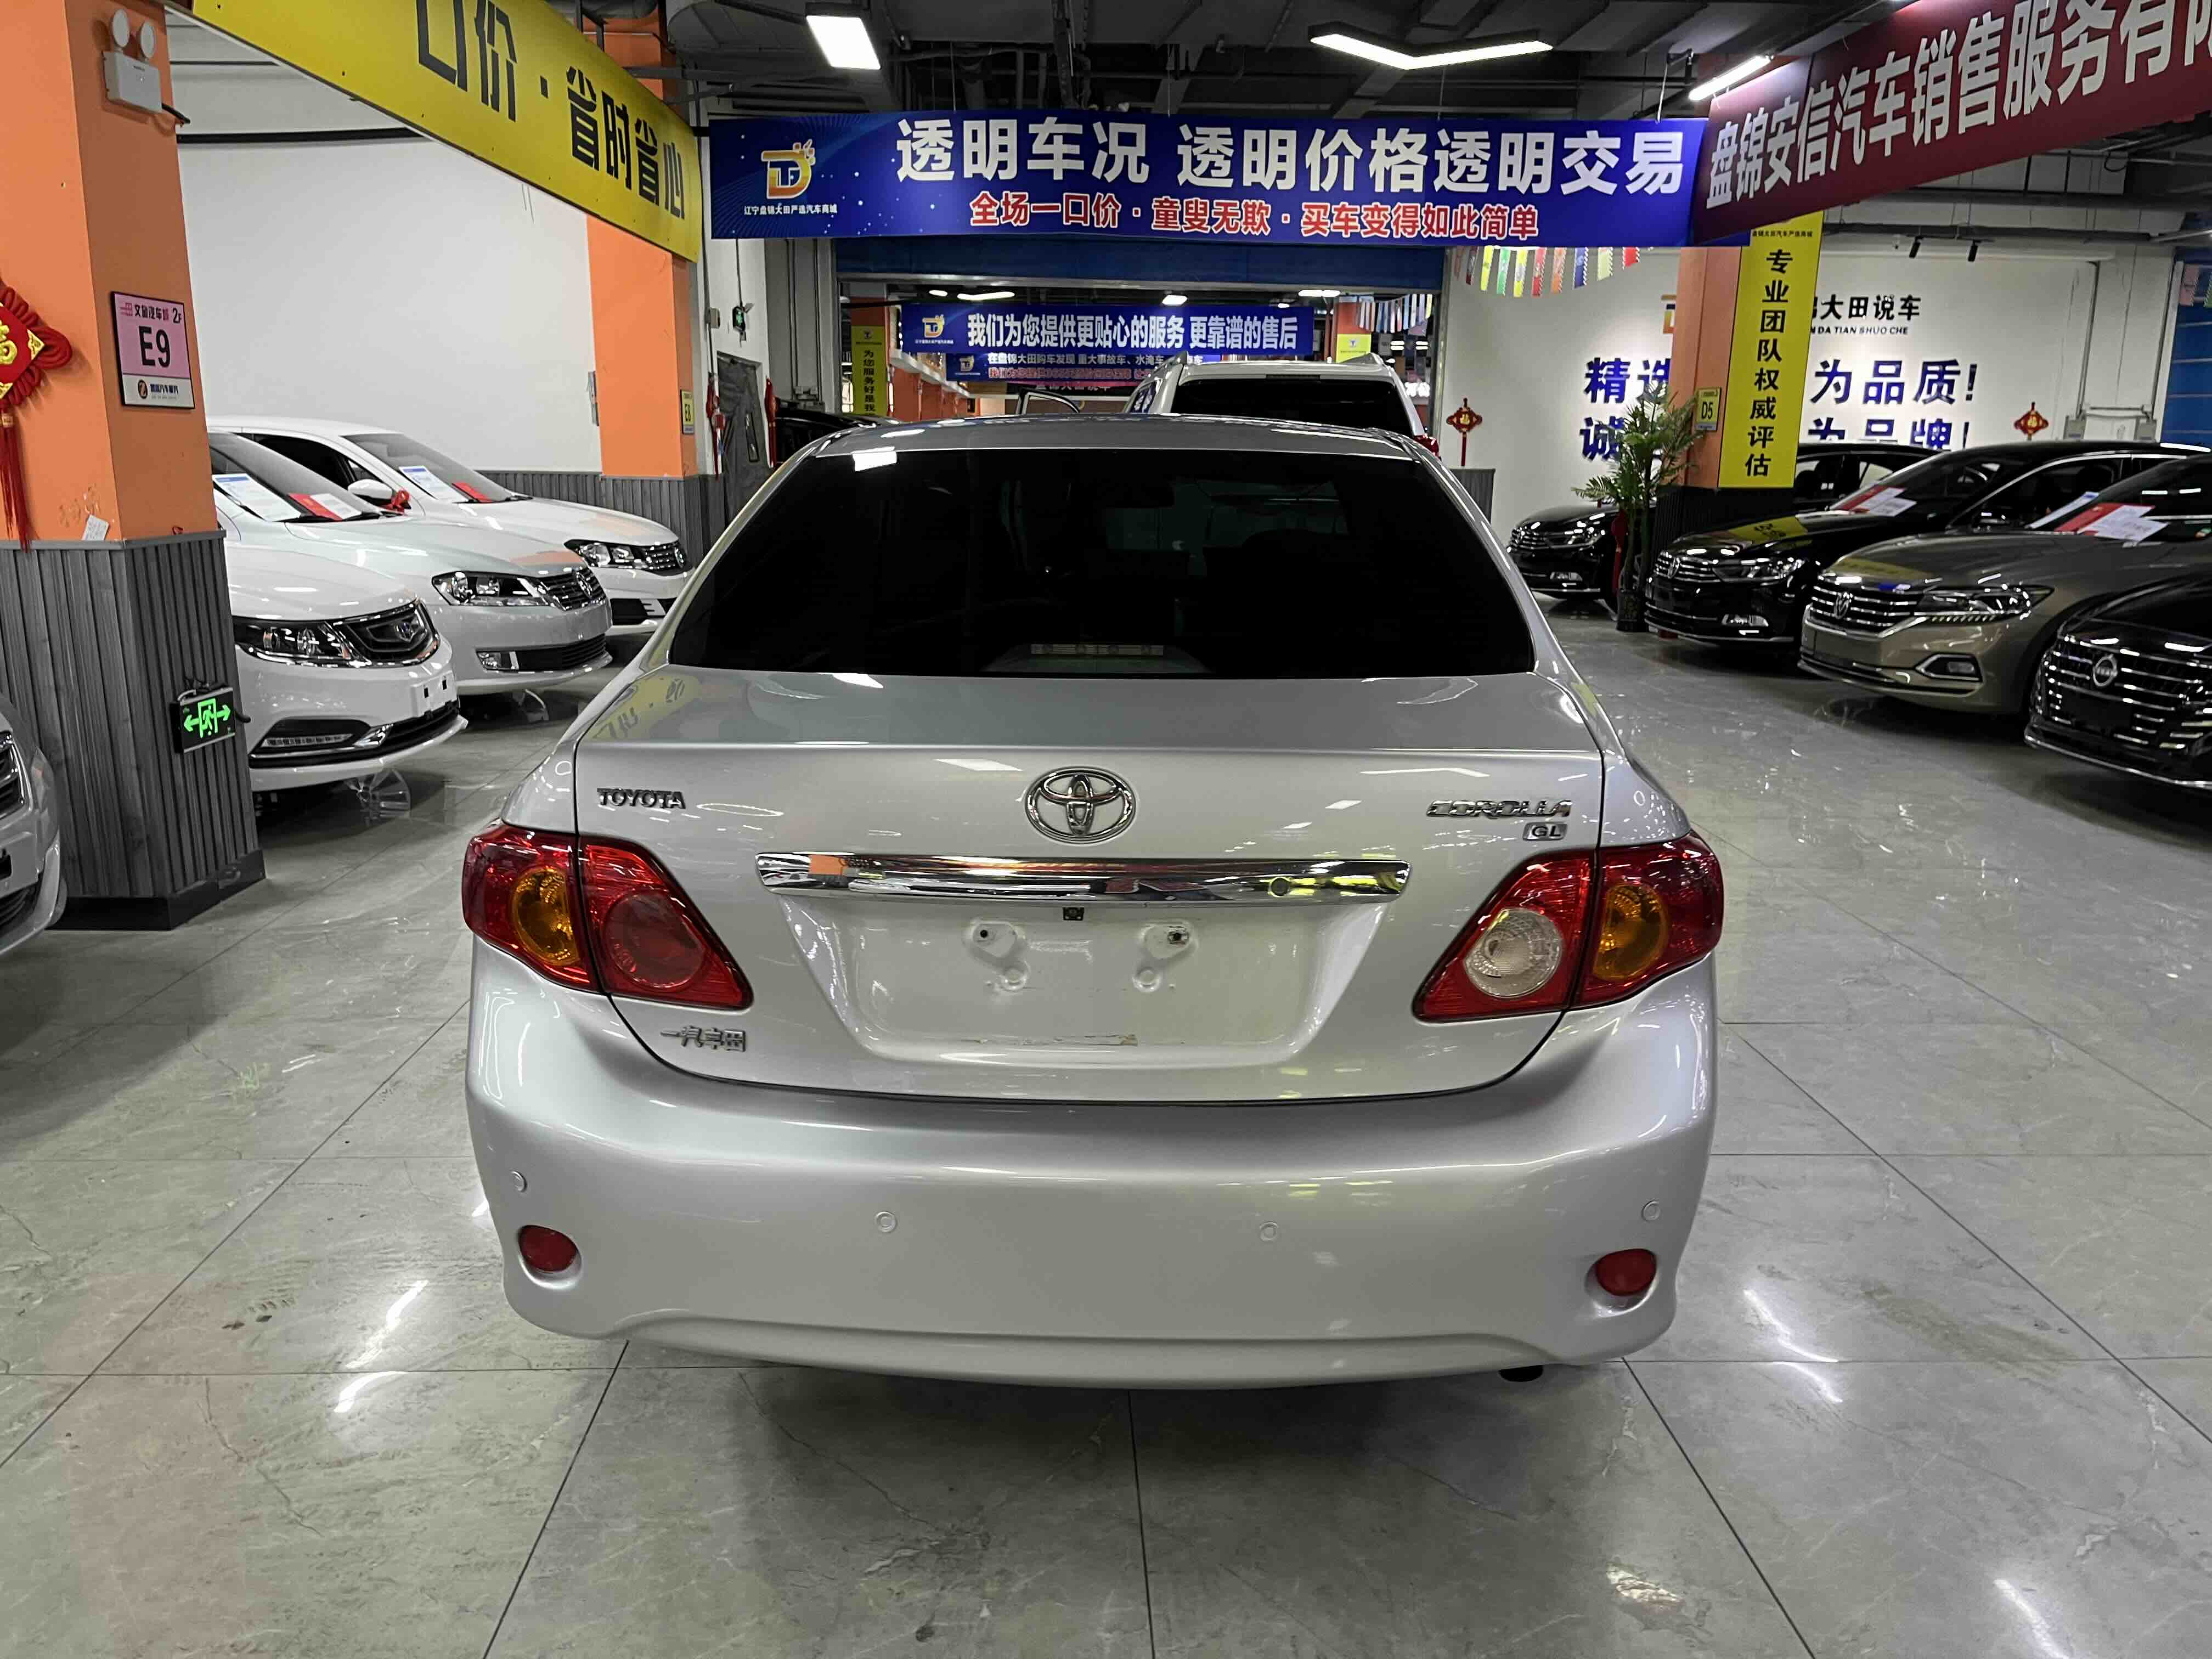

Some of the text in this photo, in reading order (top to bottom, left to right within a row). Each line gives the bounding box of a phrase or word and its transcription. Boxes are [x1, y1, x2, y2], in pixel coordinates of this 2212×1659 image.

[896, 116, 1683, 195] 透明车况 透明价格透明交易
[968, 313, 1298, 349] 我们为您提供更贴心的服务 更靠谱的售后
[1889, 326, 1908, 335] CHE
[139, 325, 171, 368] E9
[1745, 249, 1793, 477] 专业团队权威评估
[864, 350, 874, 415] 为您服务好是我
[1701, 401, 1713, 420] D5
[597, 788, 686, 809] TOYOTA
[1426, 800, 1572, 819] COROLLA
[1531, 826, 1561, 837] GL
[660, 1025, 746, 1052] 一汽丰田
